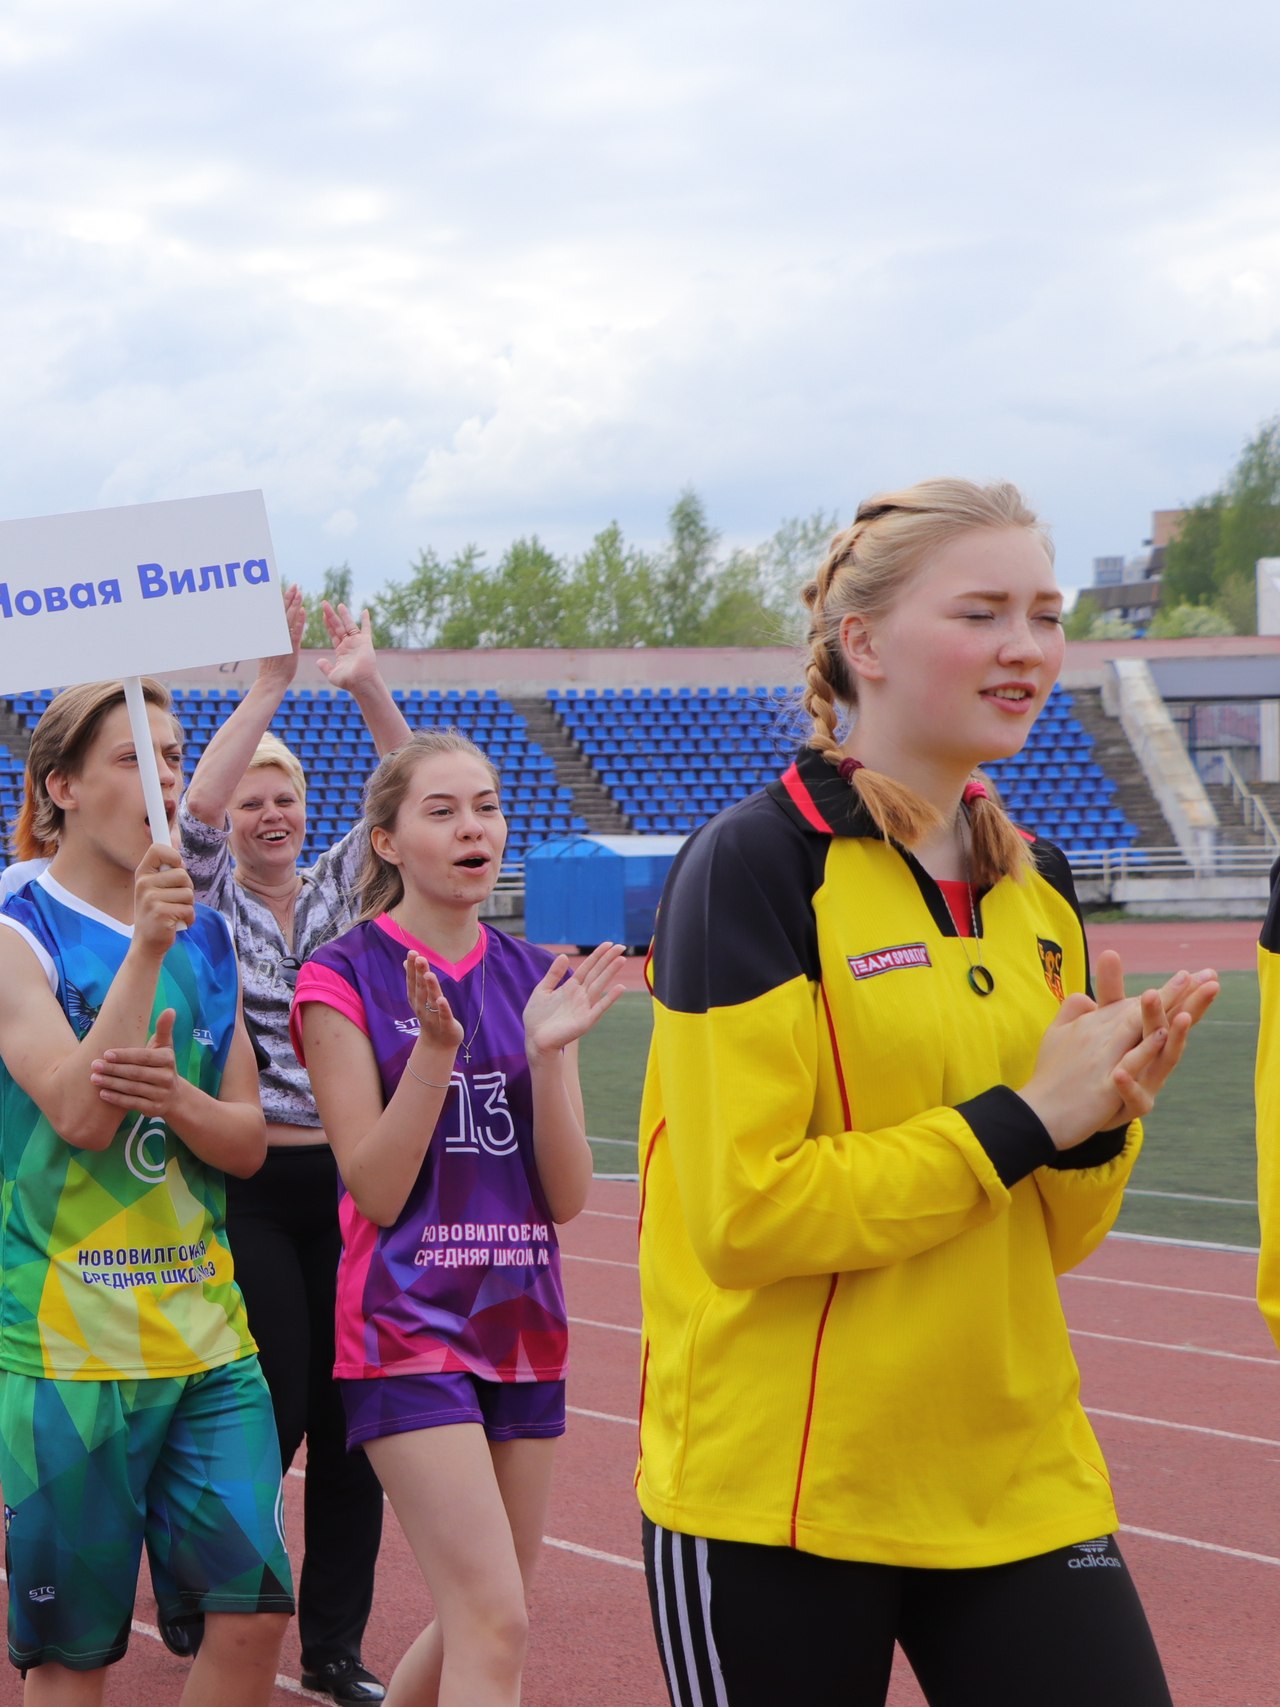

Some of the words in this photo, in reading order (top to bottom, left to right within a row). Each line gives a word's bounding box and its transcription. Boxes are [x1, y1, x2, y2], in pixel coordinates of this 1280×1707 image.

[137, 558, 270, 599] Вилга
[849, 952, 894, 975] TEAM
[445, 1071, 519, 1156] 13
[414, 1248, 489, 1268] СРЕДНЯЯ
[83, 1271, 157, 1289] СРЕДНЯЯ
[1067, 1554, 1121, 1569] adidas
